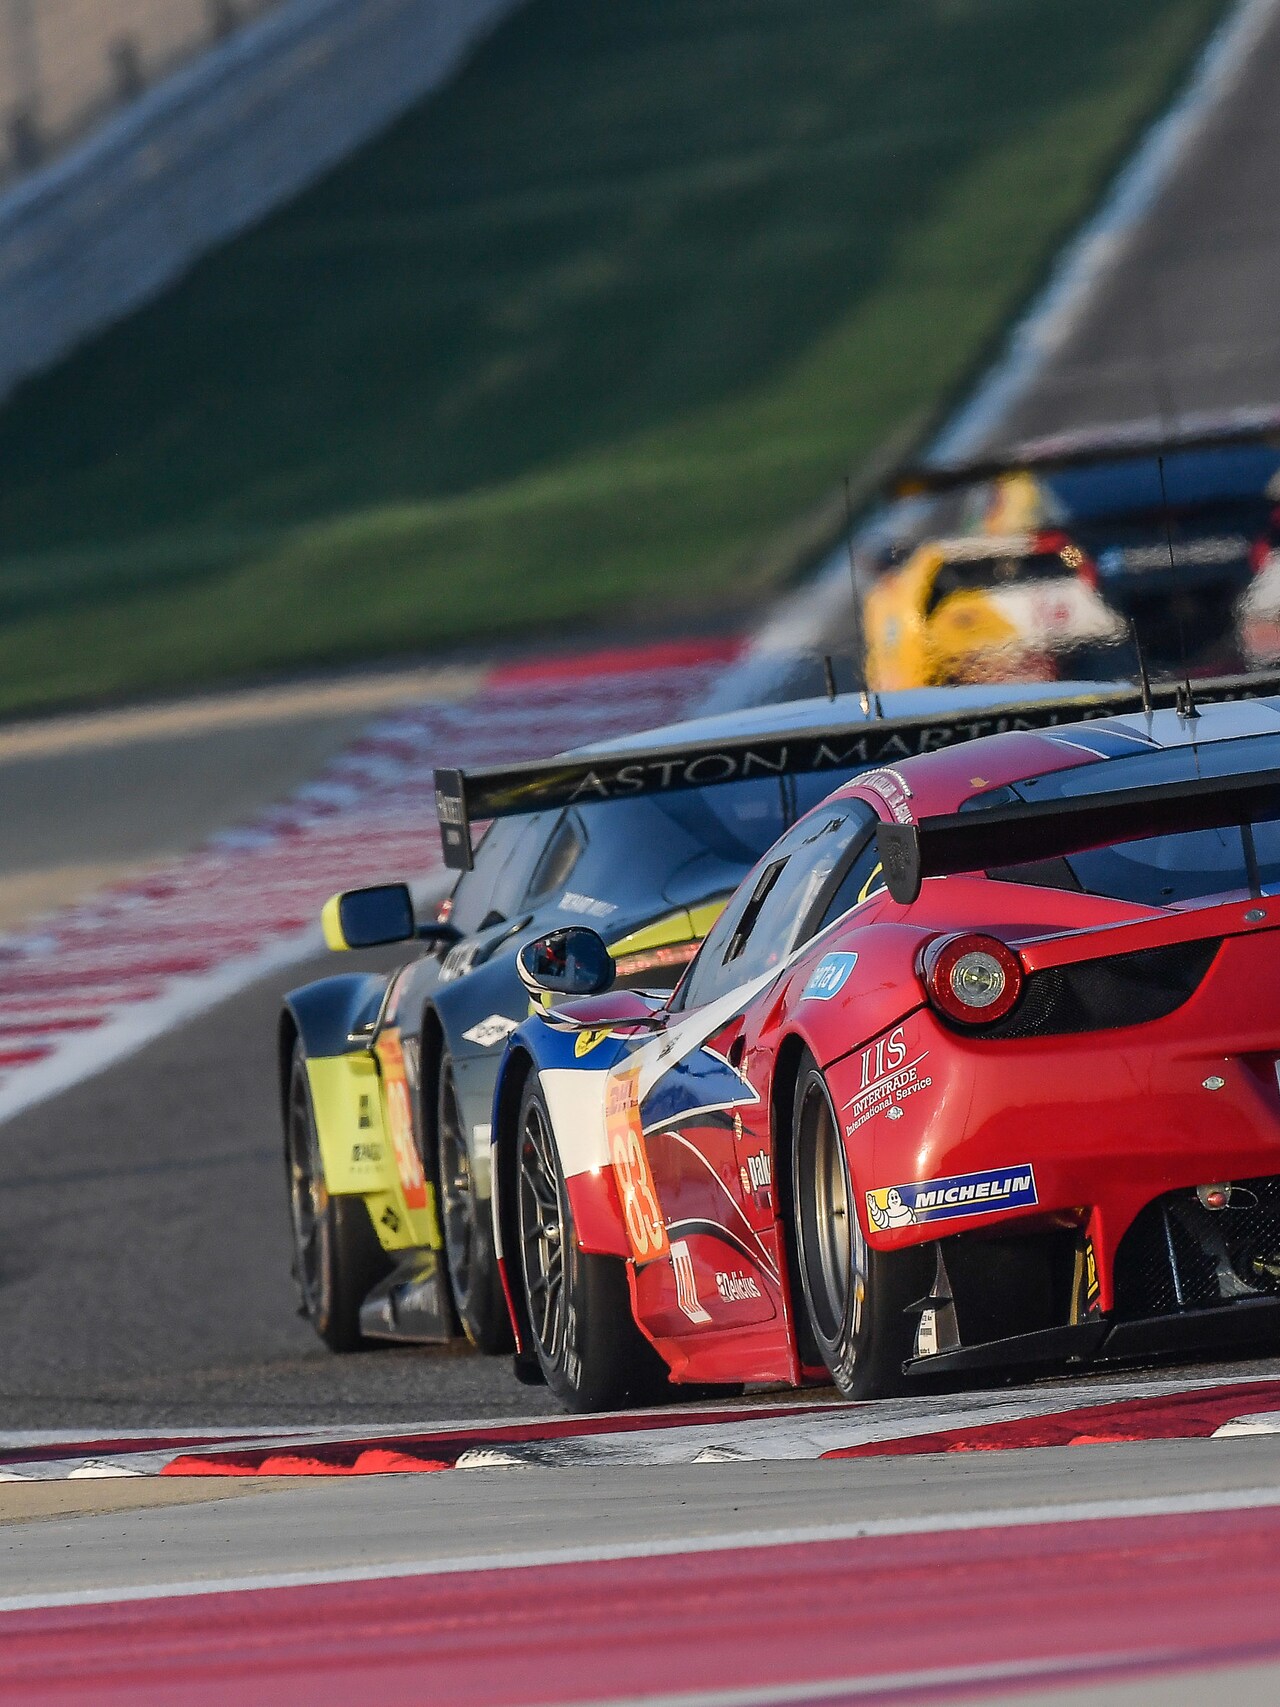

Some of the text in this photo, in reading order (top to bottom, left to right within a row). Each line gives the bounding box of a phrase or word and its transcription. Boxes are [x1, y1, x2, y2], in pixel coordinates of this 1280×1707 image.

[568, 747, 787, 801] ASTON
[860, 1026, 906, 1089] IIS
[845, 1076, 932, 1138] International Service
[853, 1067, 917, 1118] INTERTRADE
[613, 1138, 663, 1255] 83
[915, 1175, 1031, 1208] MICHELIN
